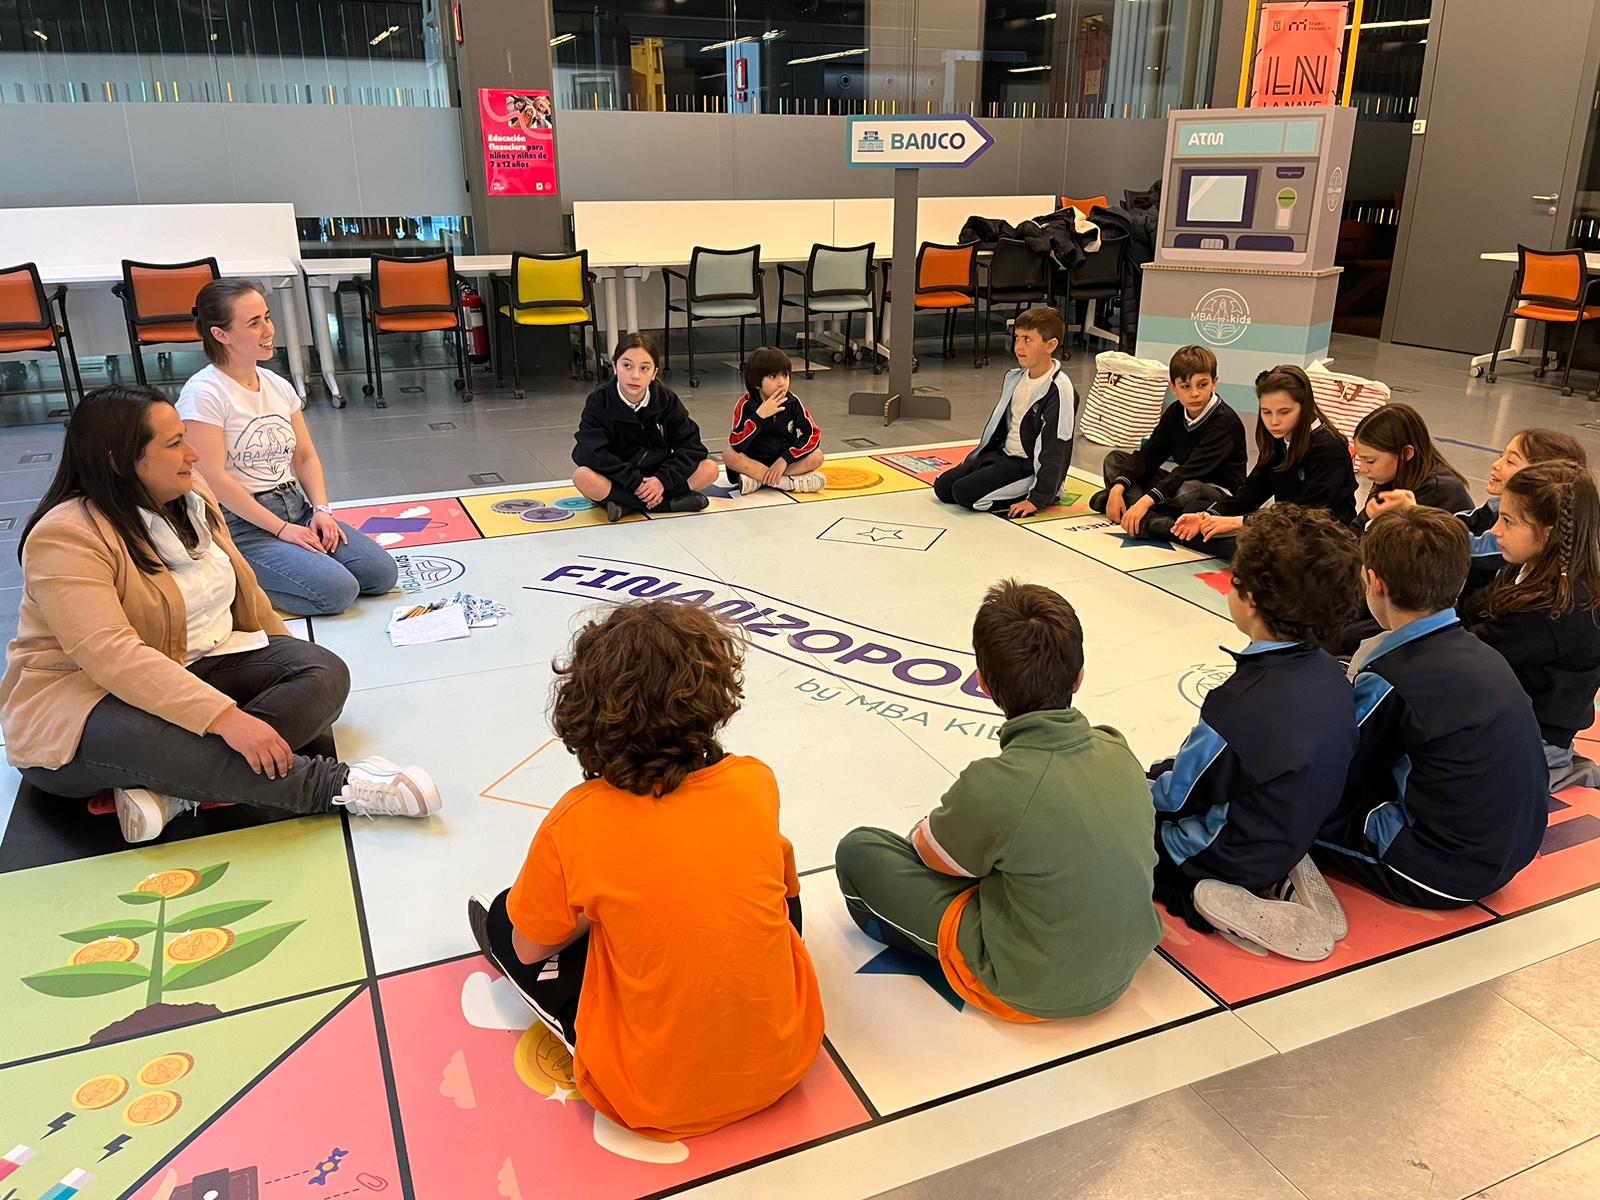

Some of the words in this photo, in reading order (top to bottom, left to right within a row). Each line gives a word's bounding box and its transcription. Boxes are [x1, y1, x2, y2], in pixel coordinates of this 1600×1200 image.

[487, 134, 527, 142] Educación
[891, 132, 966, 150] BANCO
[1188, 132, 1224, 146] ATM
[488, 143, 527, 151] financiera
[1190, 312, 1213, 321] MBA
[1230, 314, 1252, 325] kids
[227, 450, 261, 462] MBA
[541, 565, 993, 700] FINANZOPOL
[794, 678, 843, 702] by
[845, 694, 930, 728] MBA
[944, 718, 1001, 741] KID
